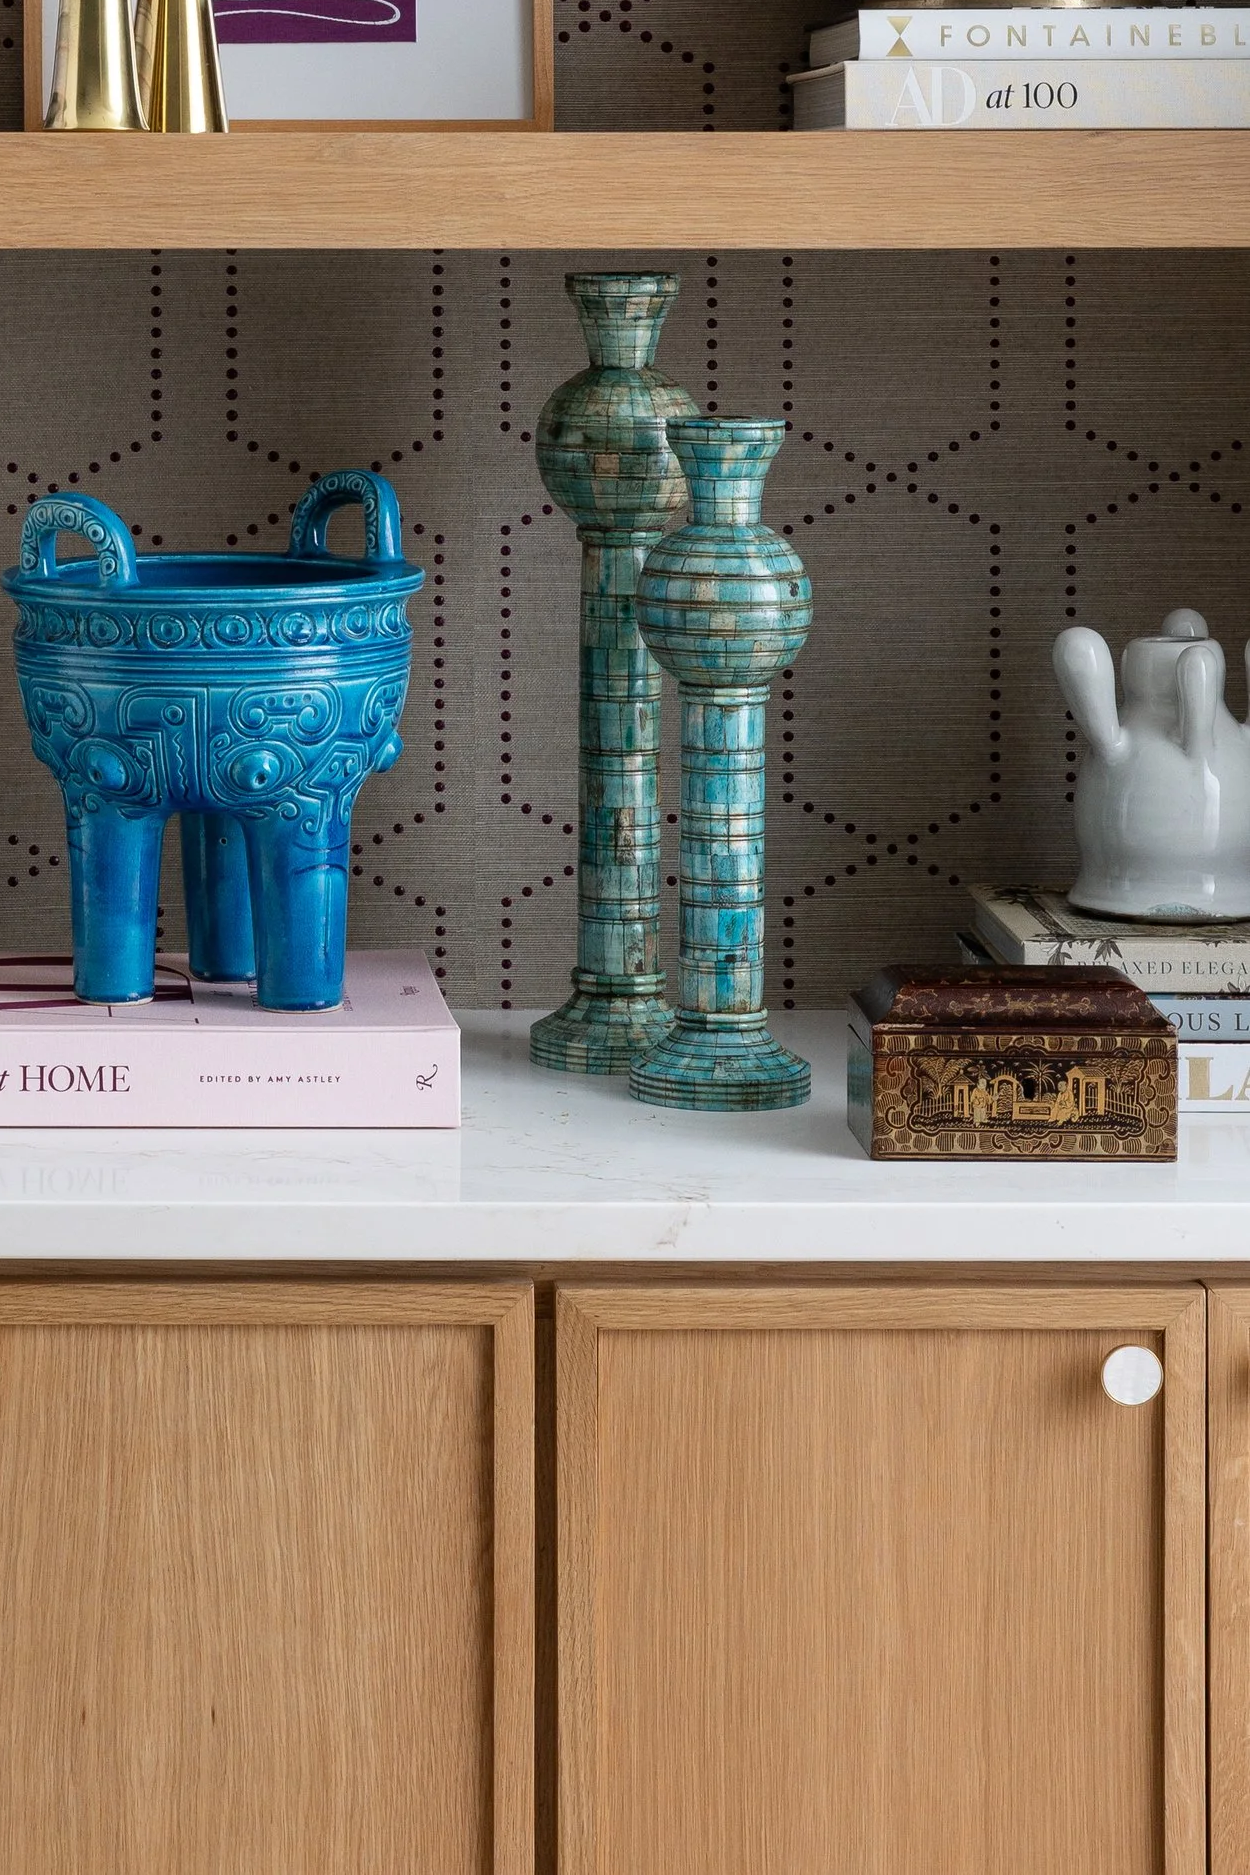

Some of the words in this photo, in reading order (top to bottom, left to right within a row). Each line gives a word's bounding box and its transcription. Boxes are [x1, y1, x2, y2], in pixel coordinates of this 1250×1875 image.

[940, 24, 1247, 47] FONTAINEBL
[884, 65, 978, 126] AD
[986, 85, 1014, 110] at
[1022, 81, 1078, 110] 100
[19, 1064, 131, 1093] HOME
[199, 1075, 242, 1084] EDITED
[248, 1075, 261, 1084] BY
[267, 1075, 292, 1084] AMY
[297, 1075, 342, 1084] ASTLEY
